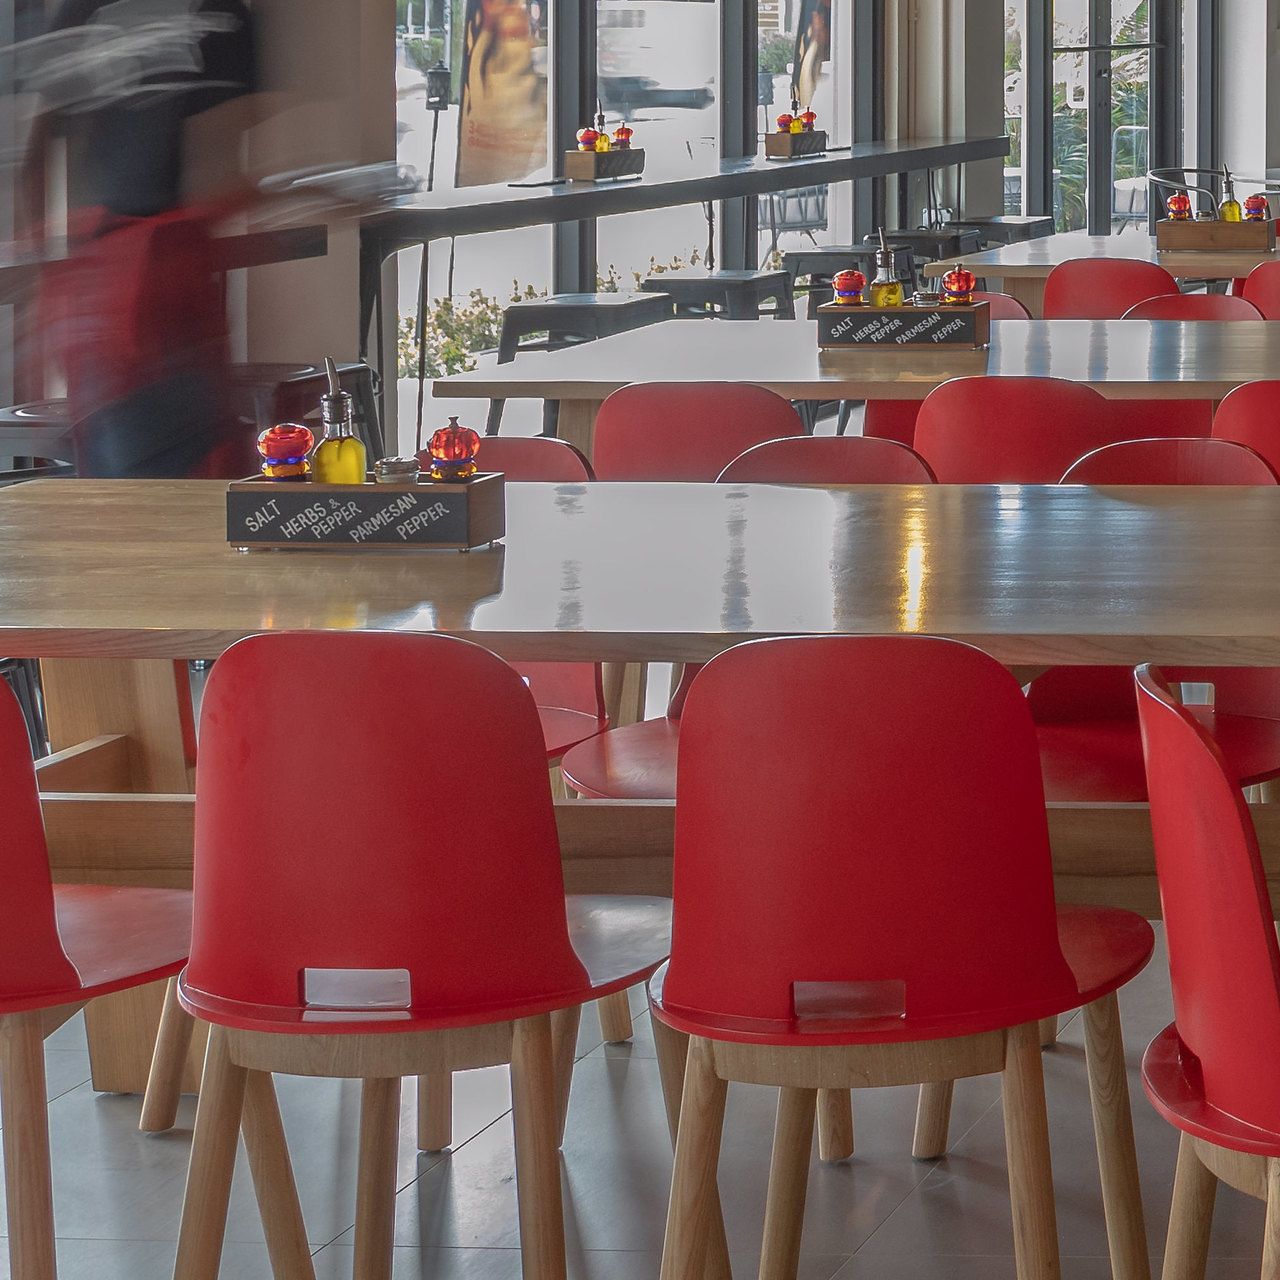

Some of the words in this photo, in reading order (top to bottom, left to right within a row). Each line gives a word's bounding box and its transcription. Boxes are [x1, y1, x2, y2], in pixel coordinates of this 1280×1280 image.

[830, 317, 854, 338] SALT
[852, 320, 881, 343] HERBS
[882, 315, 890, 324] &
[870, 318, 903, 343] PEPPER
[895, 312, 941, 344] PARMESAN
[931, 318, 966, 343] PEPPER
[245, 499, 282, 533] SALT
[280, 502, 327, 539] HERBS
[330, 498, 341, 509] &
[311, 501, 363, 539] PEPPER
[349, 493, 418, 543] PARMESAN
[396, 502, 450, 540] PEPPER
